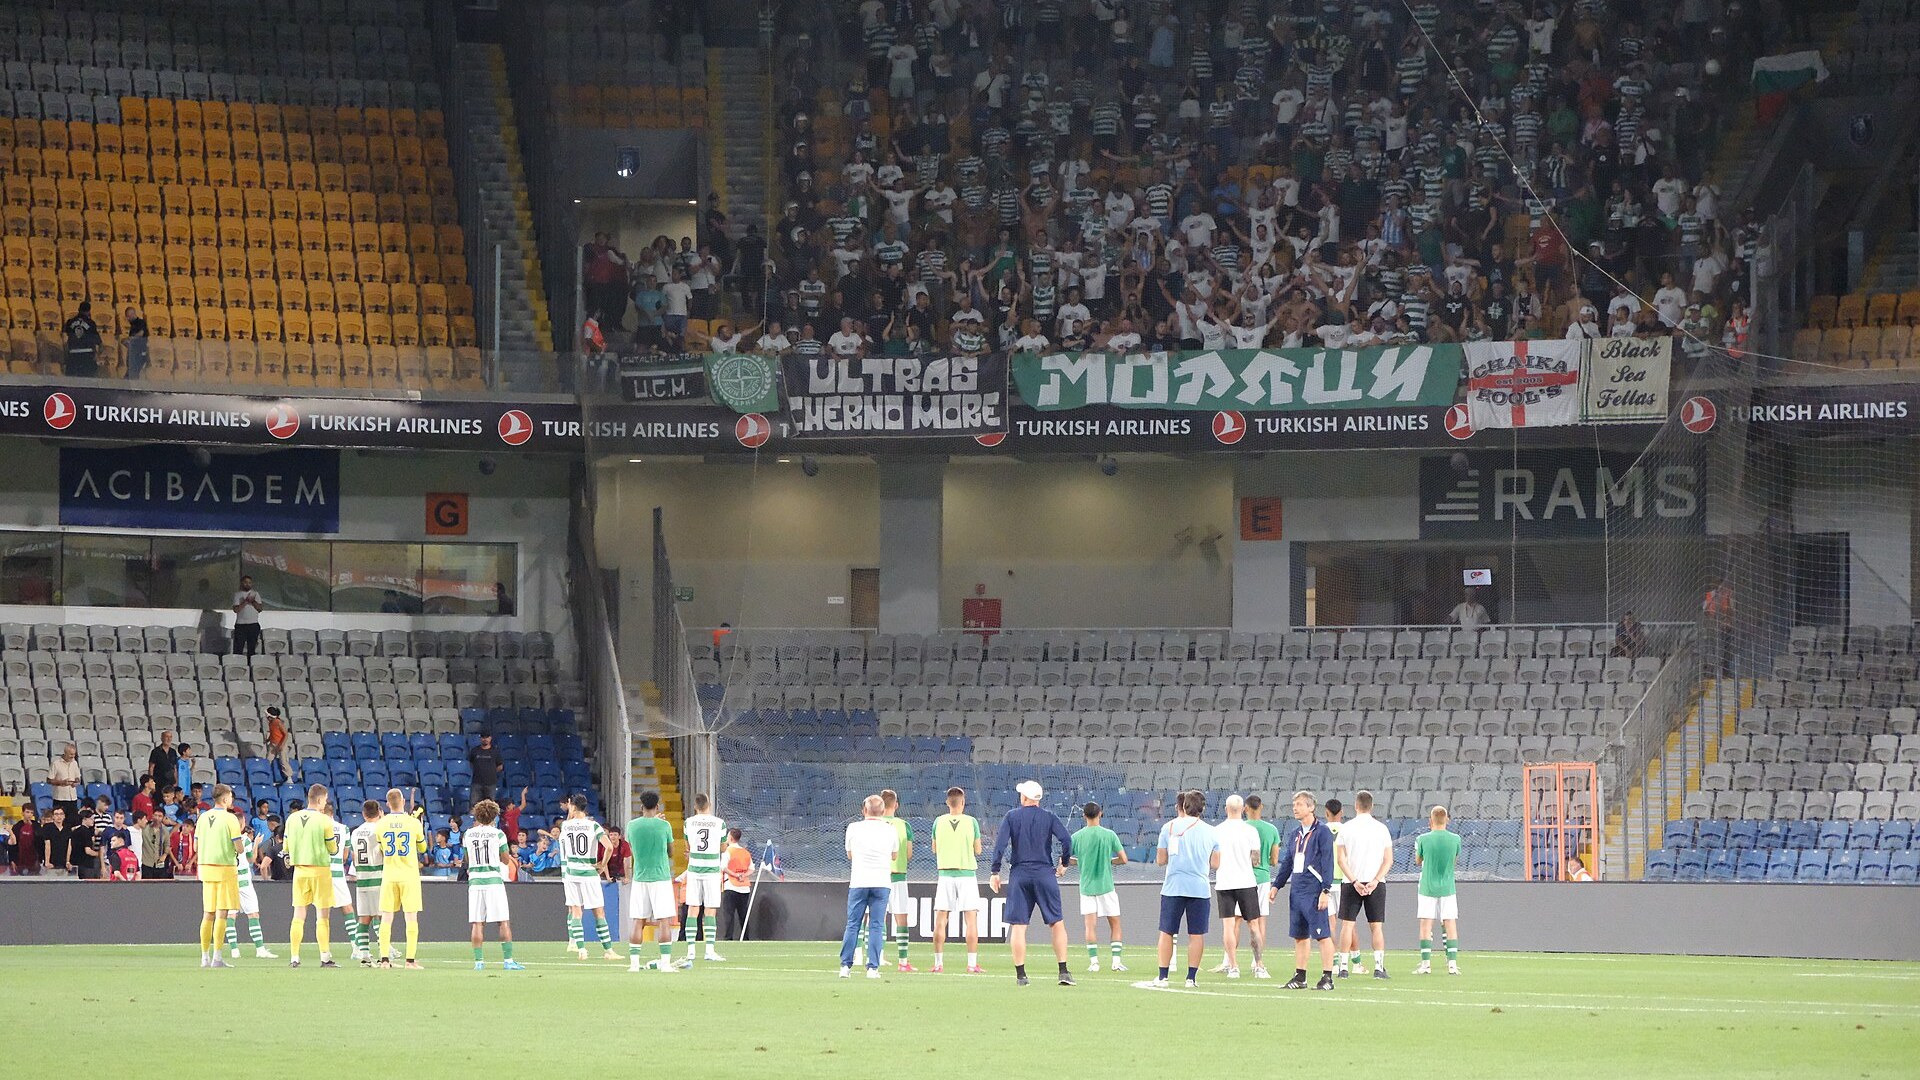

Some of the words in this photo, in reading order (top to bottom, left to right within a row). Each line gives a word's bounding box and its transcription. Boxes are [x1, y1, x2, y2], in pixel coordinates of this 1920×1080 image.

[1600, 338, 1661, 359] Black
[808, 357, 978, 394] ULTRAS
[1473, 355, 1568, 379] CHAIKA
[1610, 366, 1647, 383] Sea
[912, 391, 1001, 429] MORE
[1597, 388, 1657, 409] Fellas
[1817, 401, 1908, 420] AIRLINES
[84, 404, 163, 424] TURKISH
[168, 409, 251, 428] AIRLINES
[309, 414, 391, 432] TURKISH
[396, 417, 483, 435] AIRLINES
[1016, 420, 1100, 436] TURKISH
[1105, 419, 1191, 435] AIRLINES
[1254, 416, 1338, 433] TURKISH
[1343, 415, 1429, 431] AIRLINES
[632, 422, 720, 438] AIRLINES
[73, 469, 325, 506] ACIBADEM
[1493, 465, 1698, 521] RAMS
[434, 501, 460, 528] G
[1251, 505, 1272, 533] E
[357, 838, 369, 864] 2
[383, 832, 410, 857] 33
[567, 833, 588, 856] 10
[697, 829, 709, 851] 3
[472, 840, 489, 865] 11
